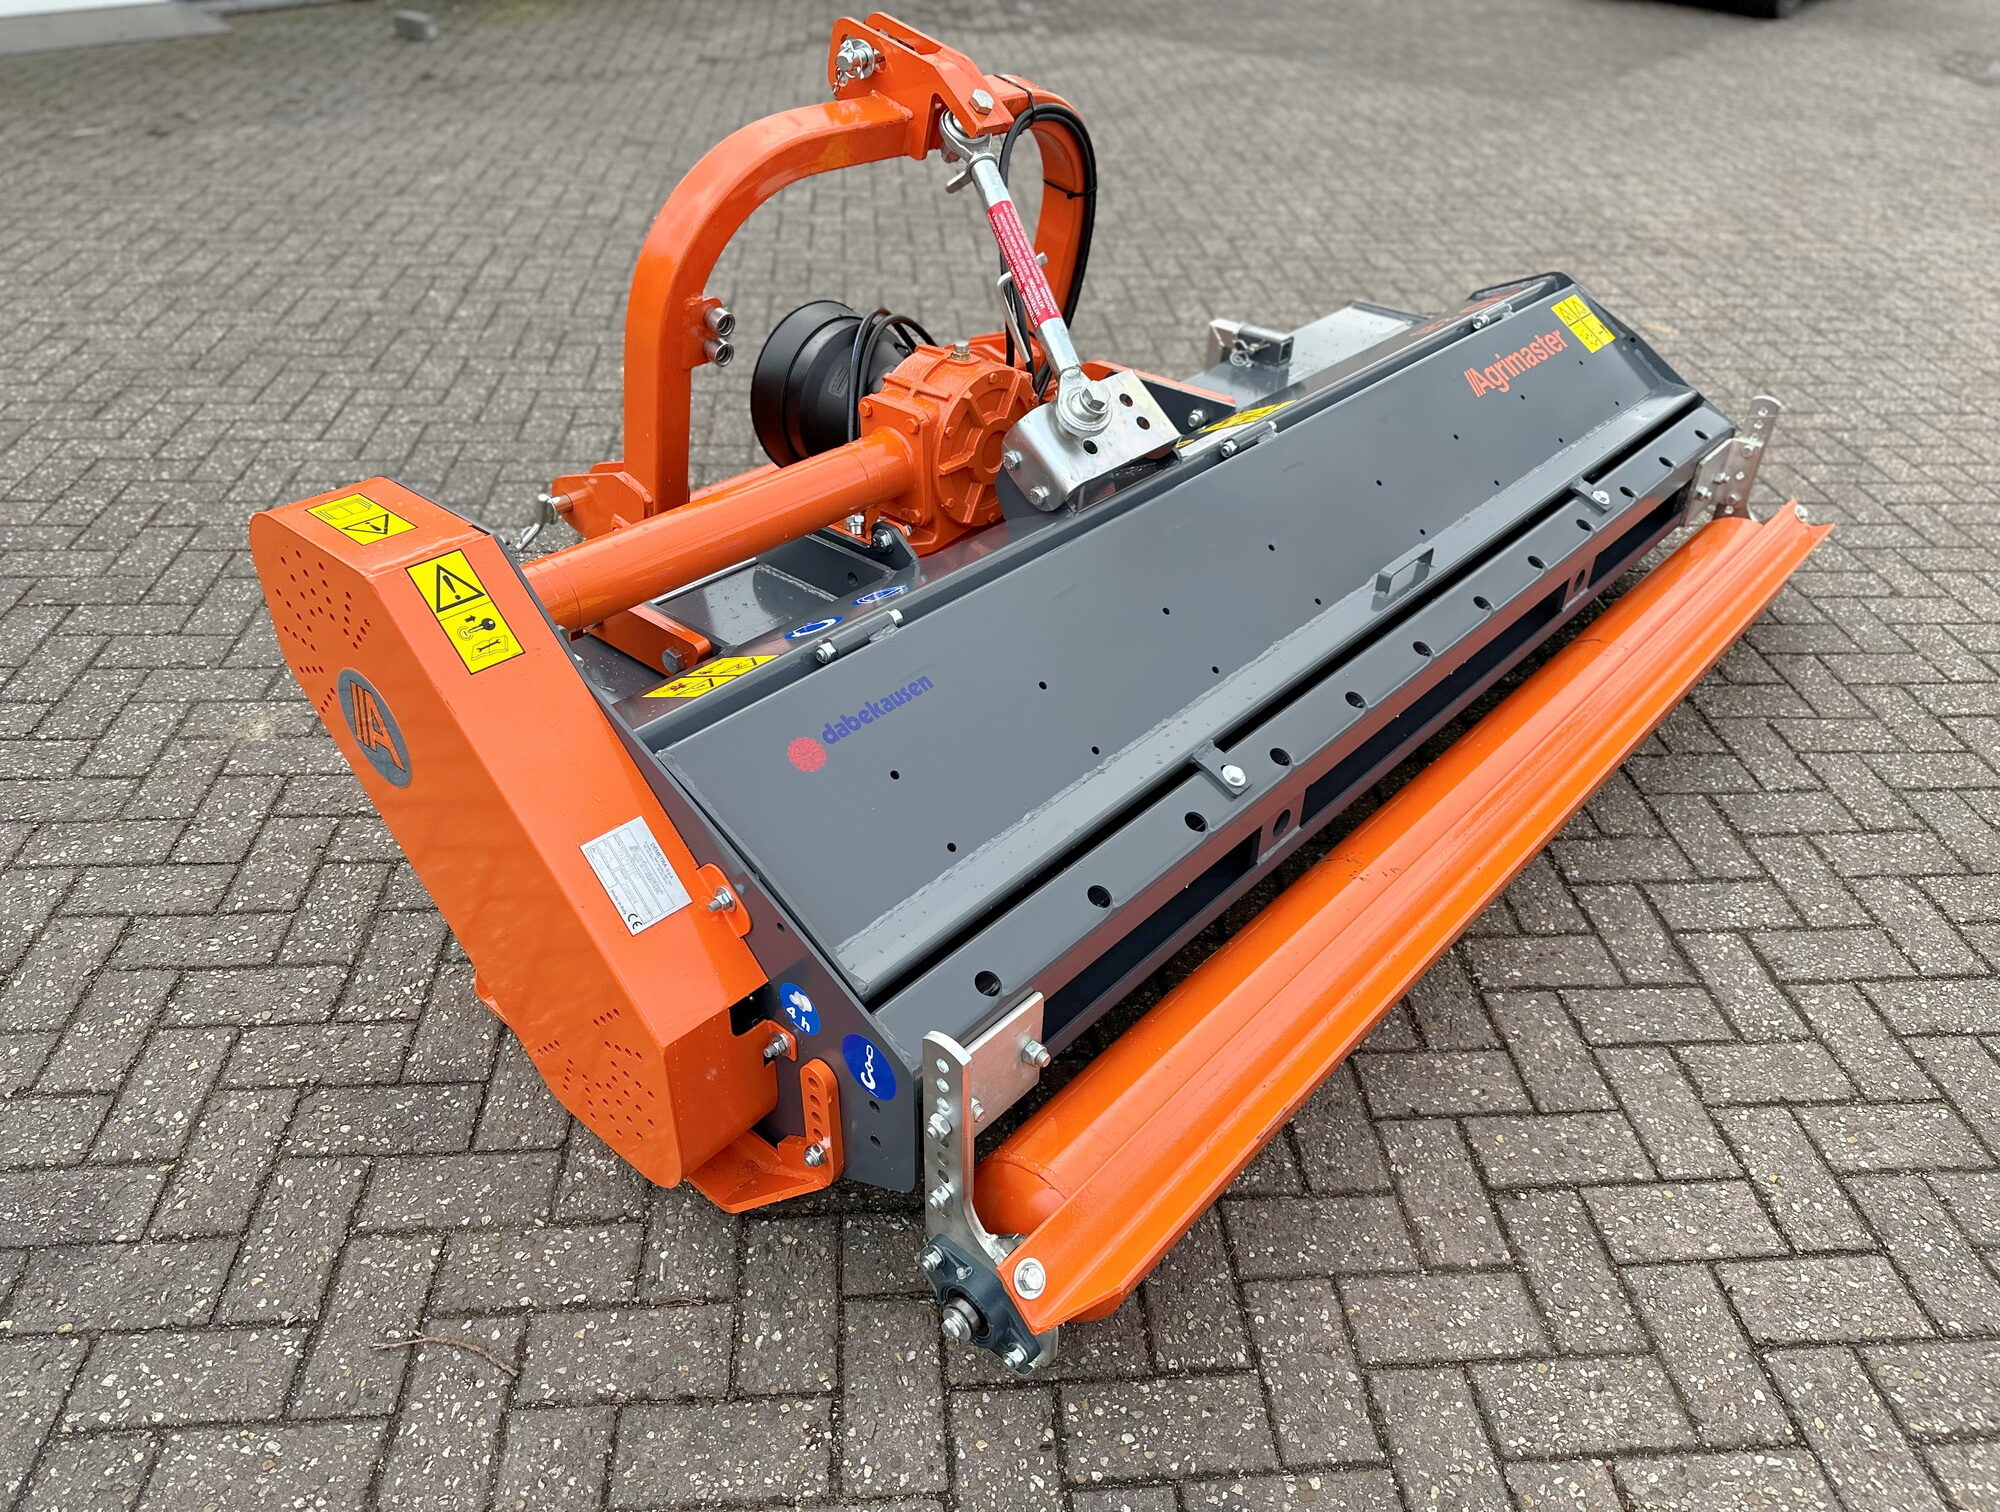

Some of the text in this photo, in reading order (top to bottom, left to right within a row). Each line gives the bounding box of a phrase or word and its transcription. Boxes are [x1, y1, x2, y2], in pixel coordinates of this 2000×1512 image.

[822, 676, 934, 744] dabekausen
[649, 842, 668, 867] DEMETRA
[627, 913, 643, 930] CE
[786, 1006, 811, 1033] 4 h
